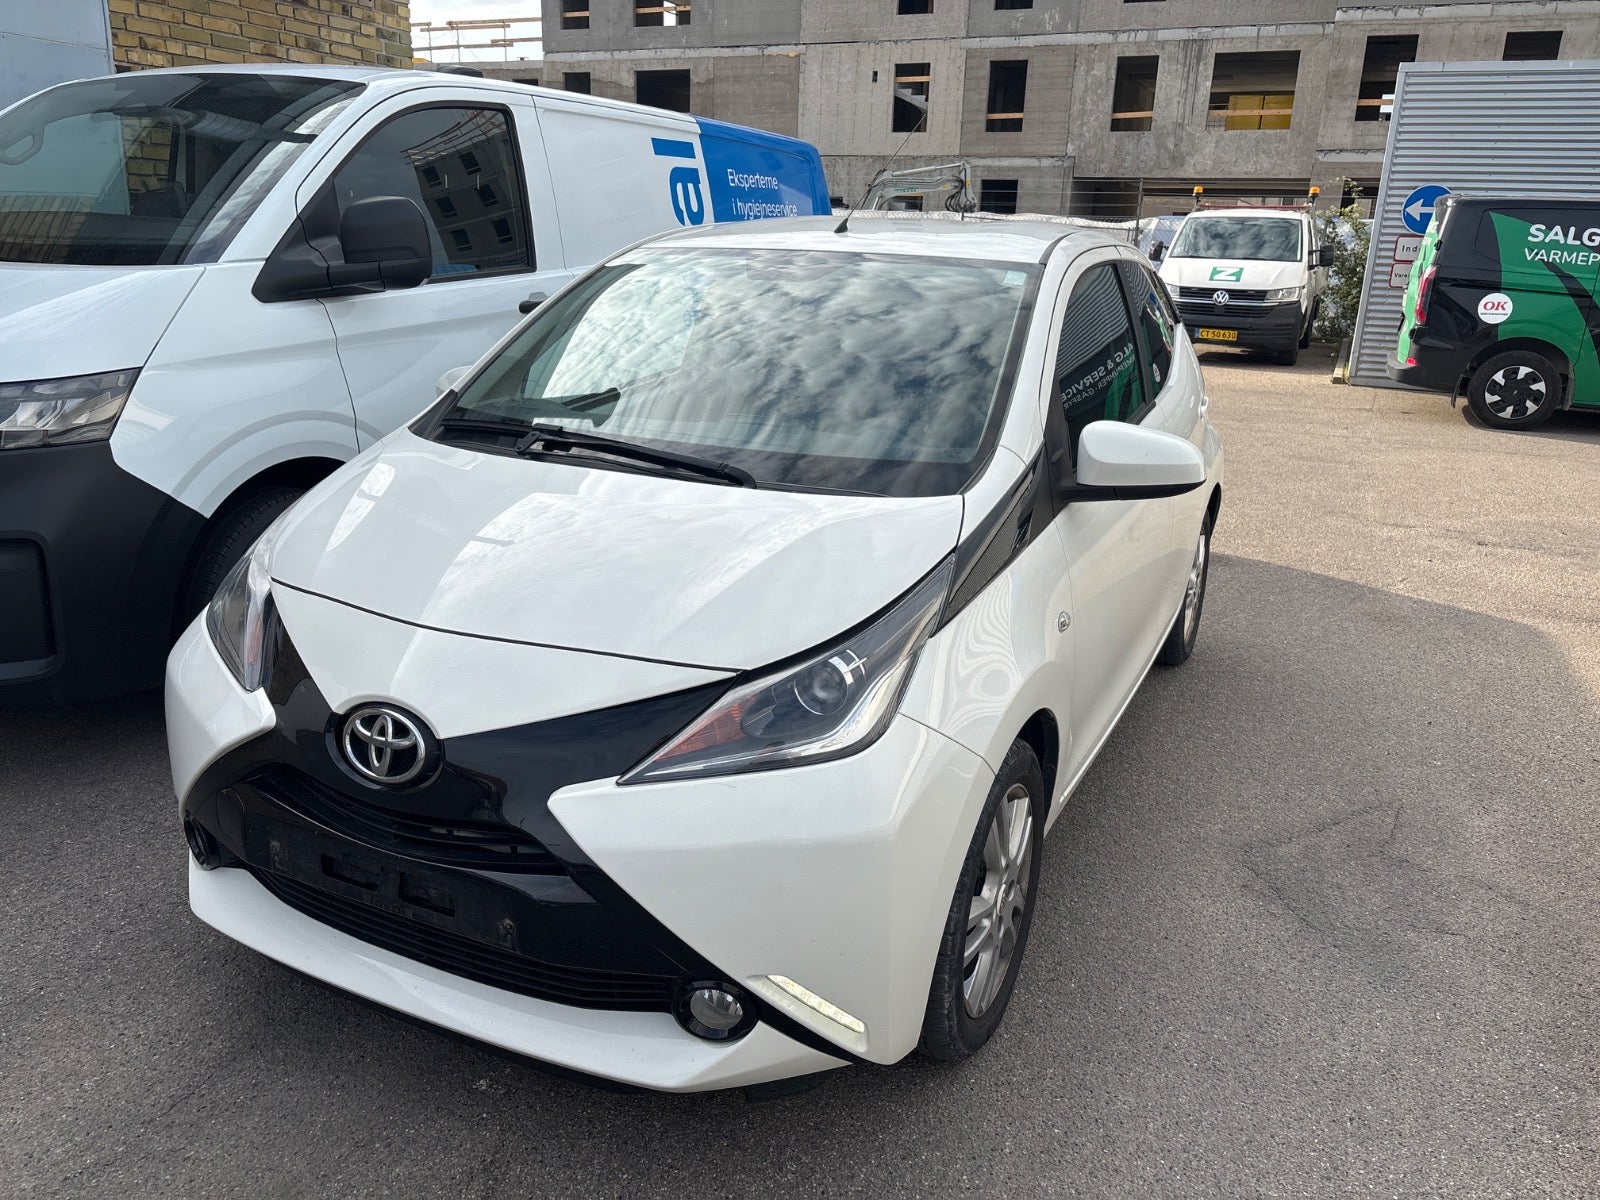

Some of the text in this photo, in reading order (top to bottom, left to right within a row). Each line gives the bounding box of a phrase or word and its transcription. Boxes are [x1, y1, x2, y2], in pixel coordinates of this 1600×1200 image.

[727, 168, 779, 191] Eksperterne
[731, 198, 798, 220] i hygiejneservice
[1527, 223, 1600, 247] SALG
[1524, 247, 1600, 266] VARMEP
[1483, 301, 1509, 311] OK
[1222, 331, 1236, 339] 630
